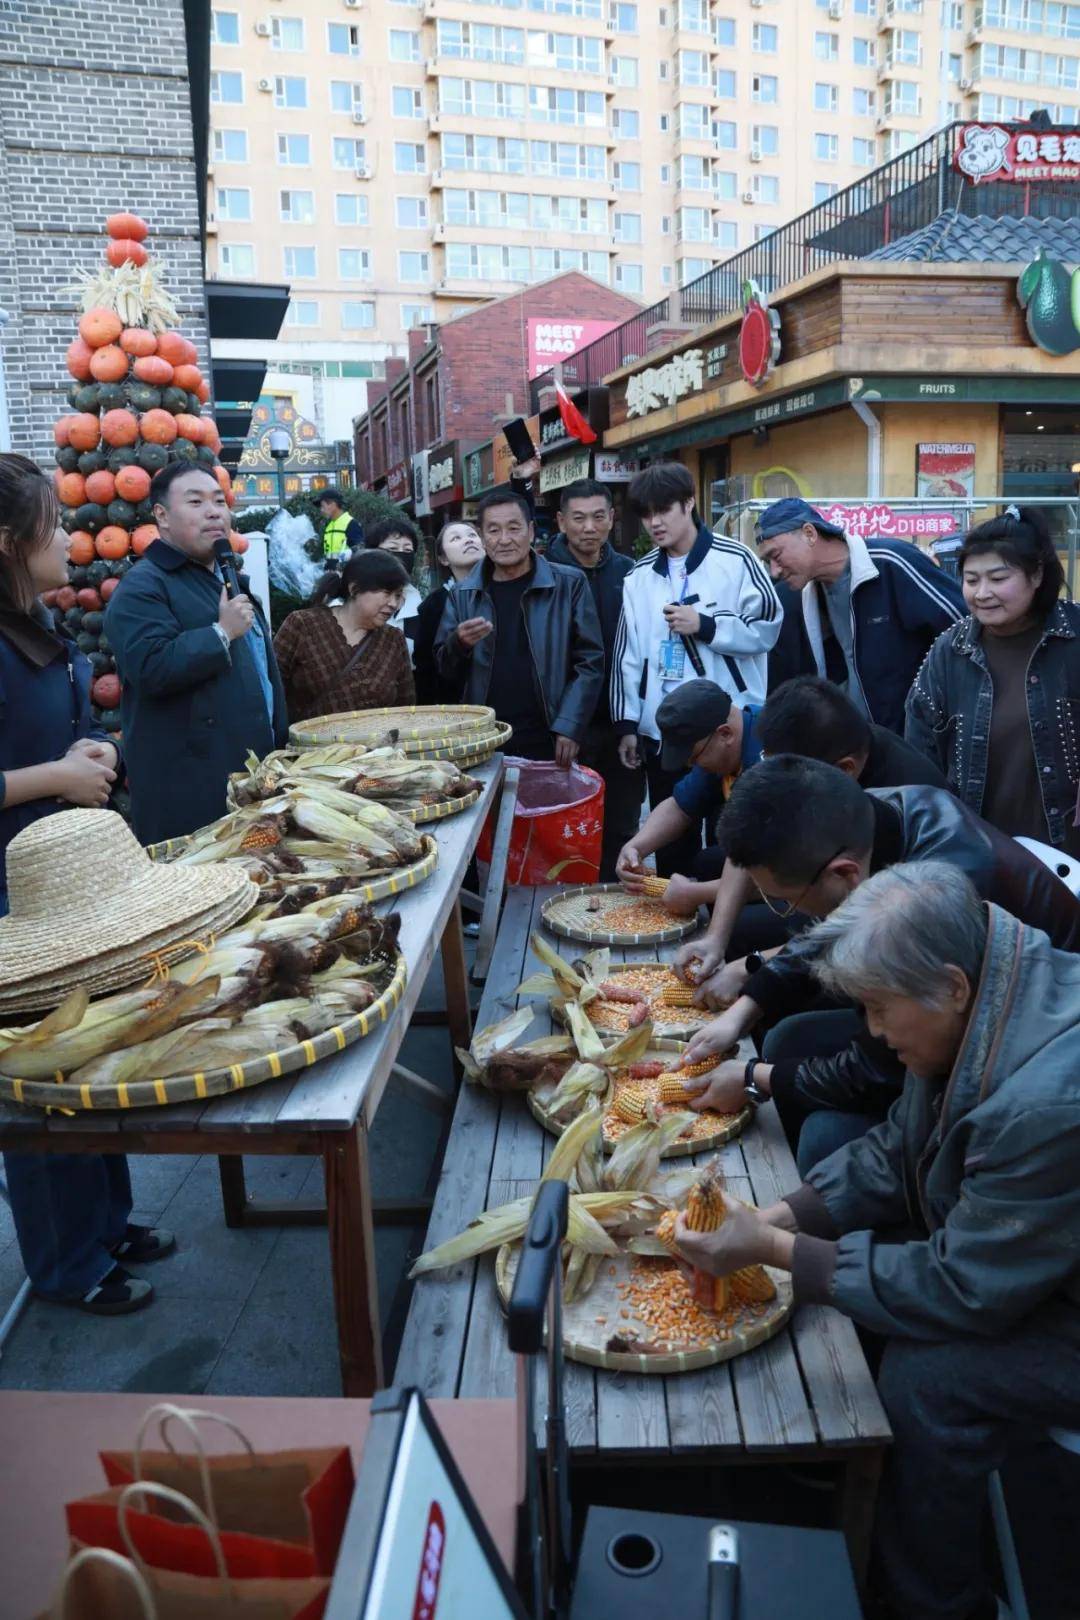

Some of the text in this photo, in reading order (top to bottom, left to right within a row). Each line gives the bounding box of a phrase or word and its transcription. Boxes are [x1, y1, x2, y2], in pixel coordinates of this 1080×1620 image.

[1014, 166, 1079, 178] MEET MAO
[535, 324, 583, 339] MEET
[535, 339, 576, 353] MAO
[919, 384, 956, 394] FRUITS
[919, 444, 975, 453] WATERMELON
